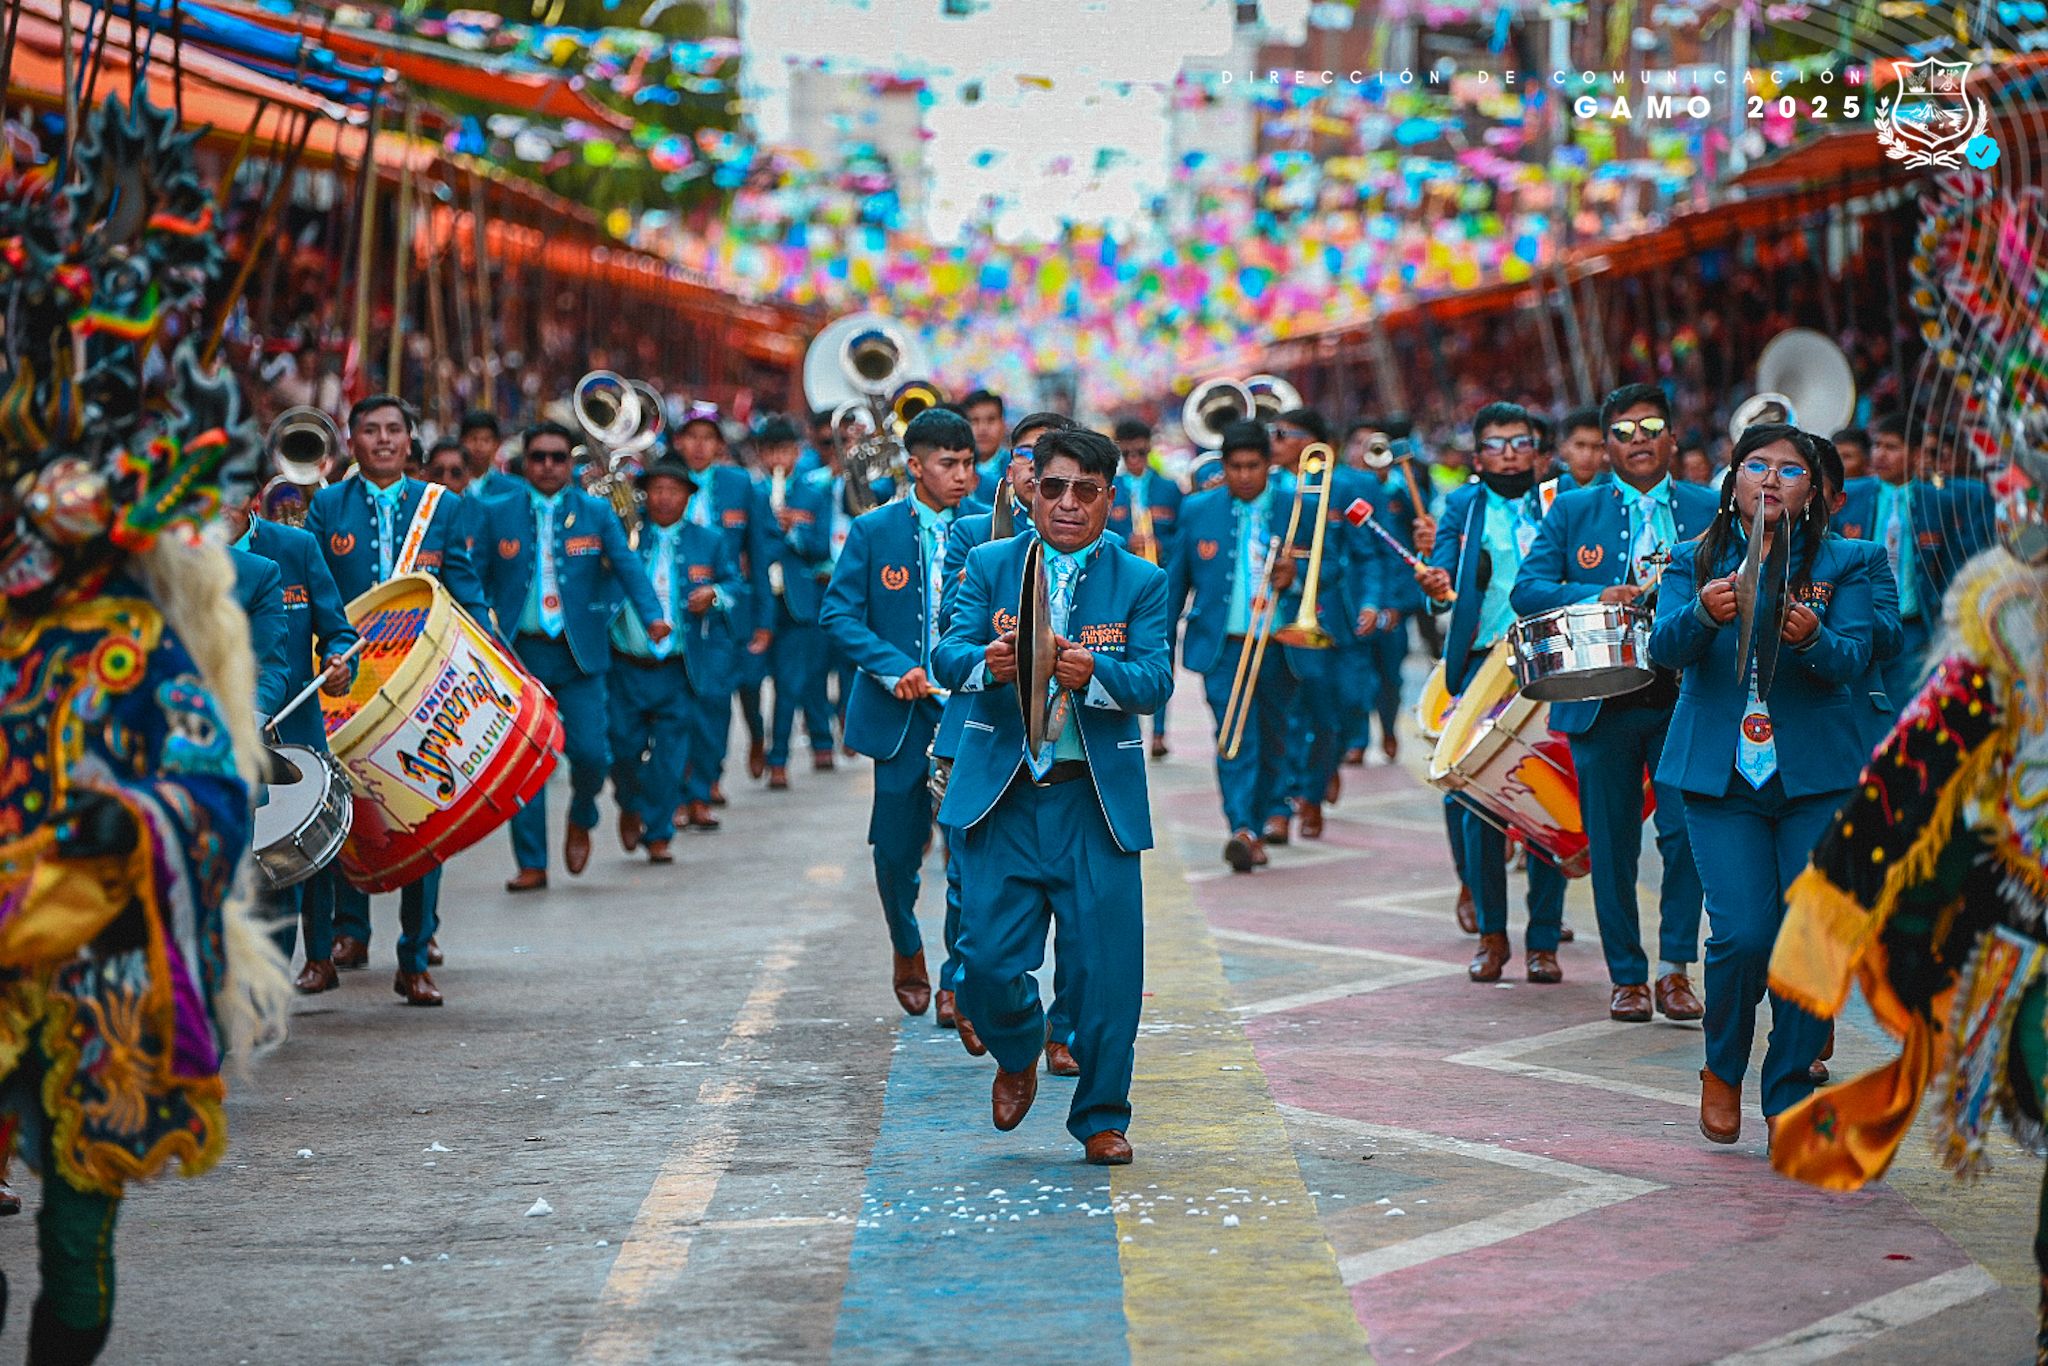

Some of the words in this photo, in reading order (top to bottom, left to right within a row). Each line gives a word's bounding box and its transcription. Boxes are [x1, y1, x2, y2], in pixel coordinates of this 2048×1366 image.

[1000, 613, 1018, 626] 24
[415, 664, 459, 724] UNION
[396, 650, 519, 802] Imperial
[459, 711, 509, 777] BOLIVIA
